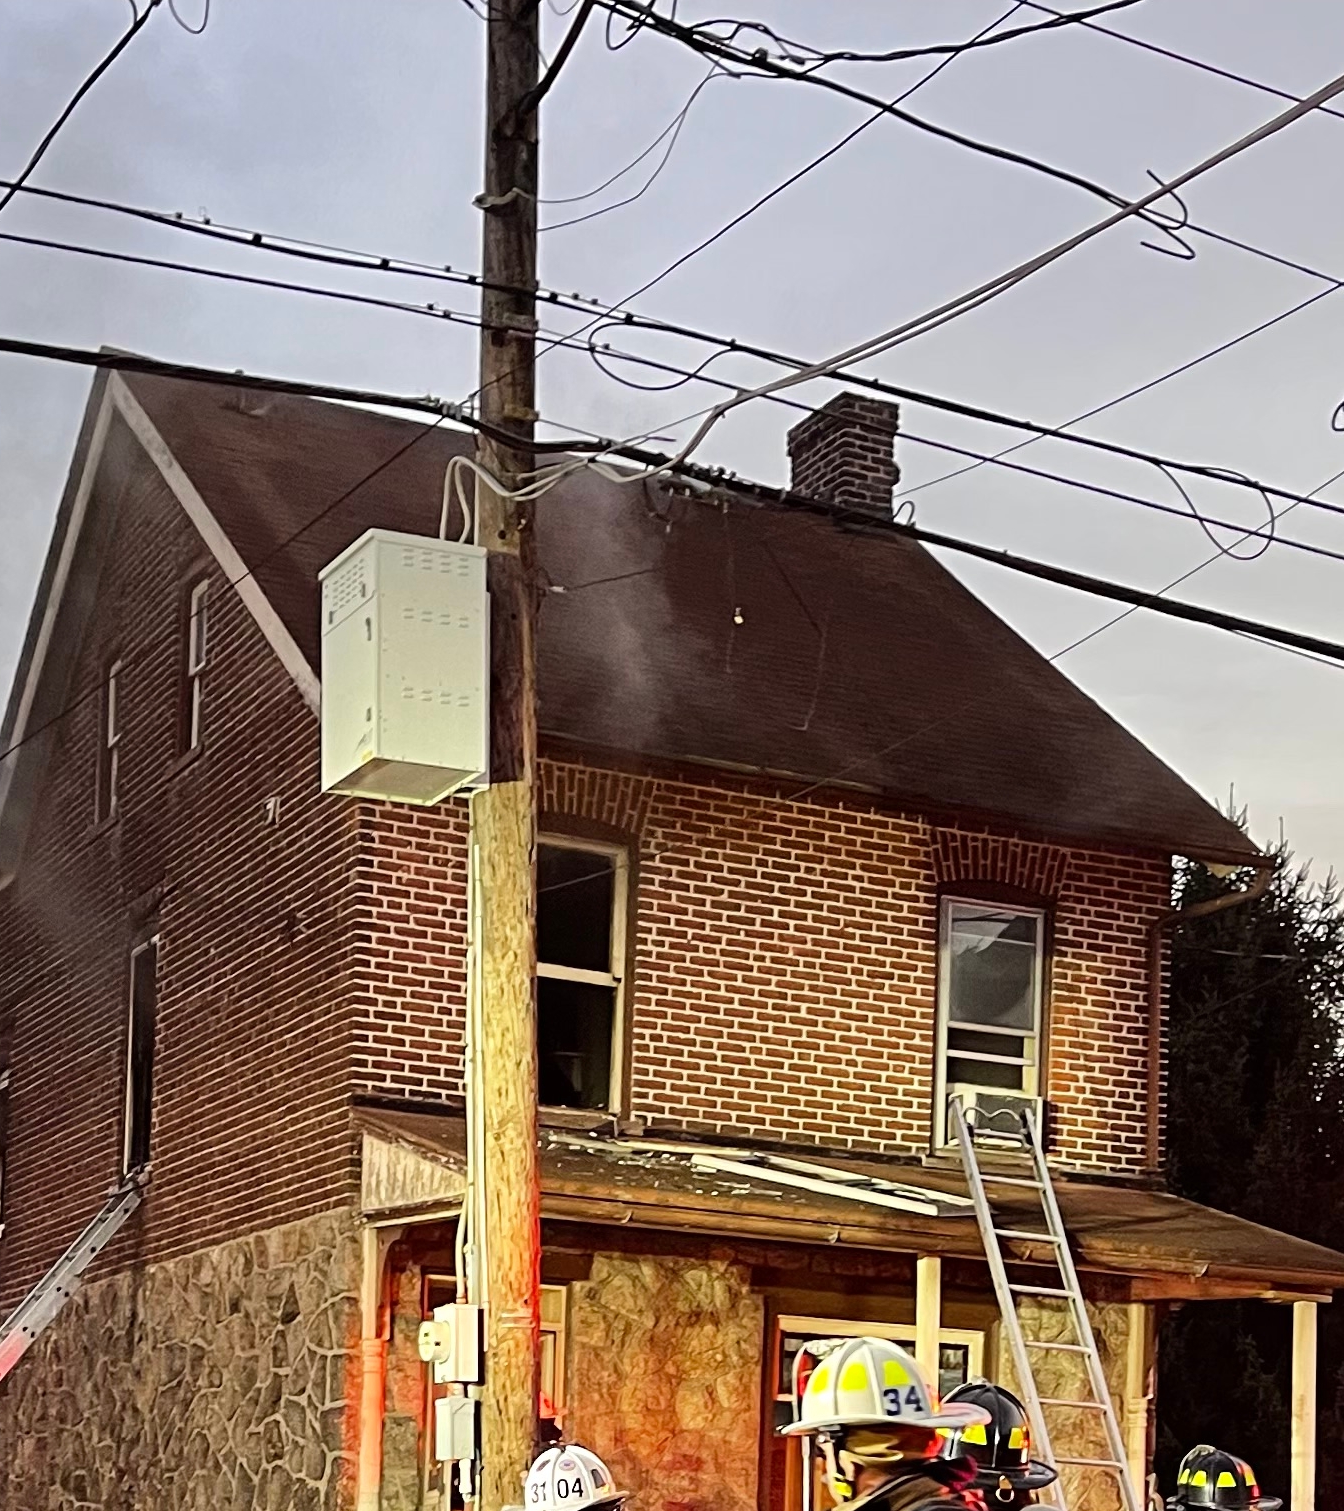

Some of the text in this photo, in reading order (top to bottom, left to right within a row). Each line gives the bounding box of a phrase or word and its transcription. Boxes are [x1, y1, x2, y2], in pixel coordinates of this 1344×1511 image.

[882, 1387, 926, 1416] 34
[530, 1478, 584, 1503] 31 04
